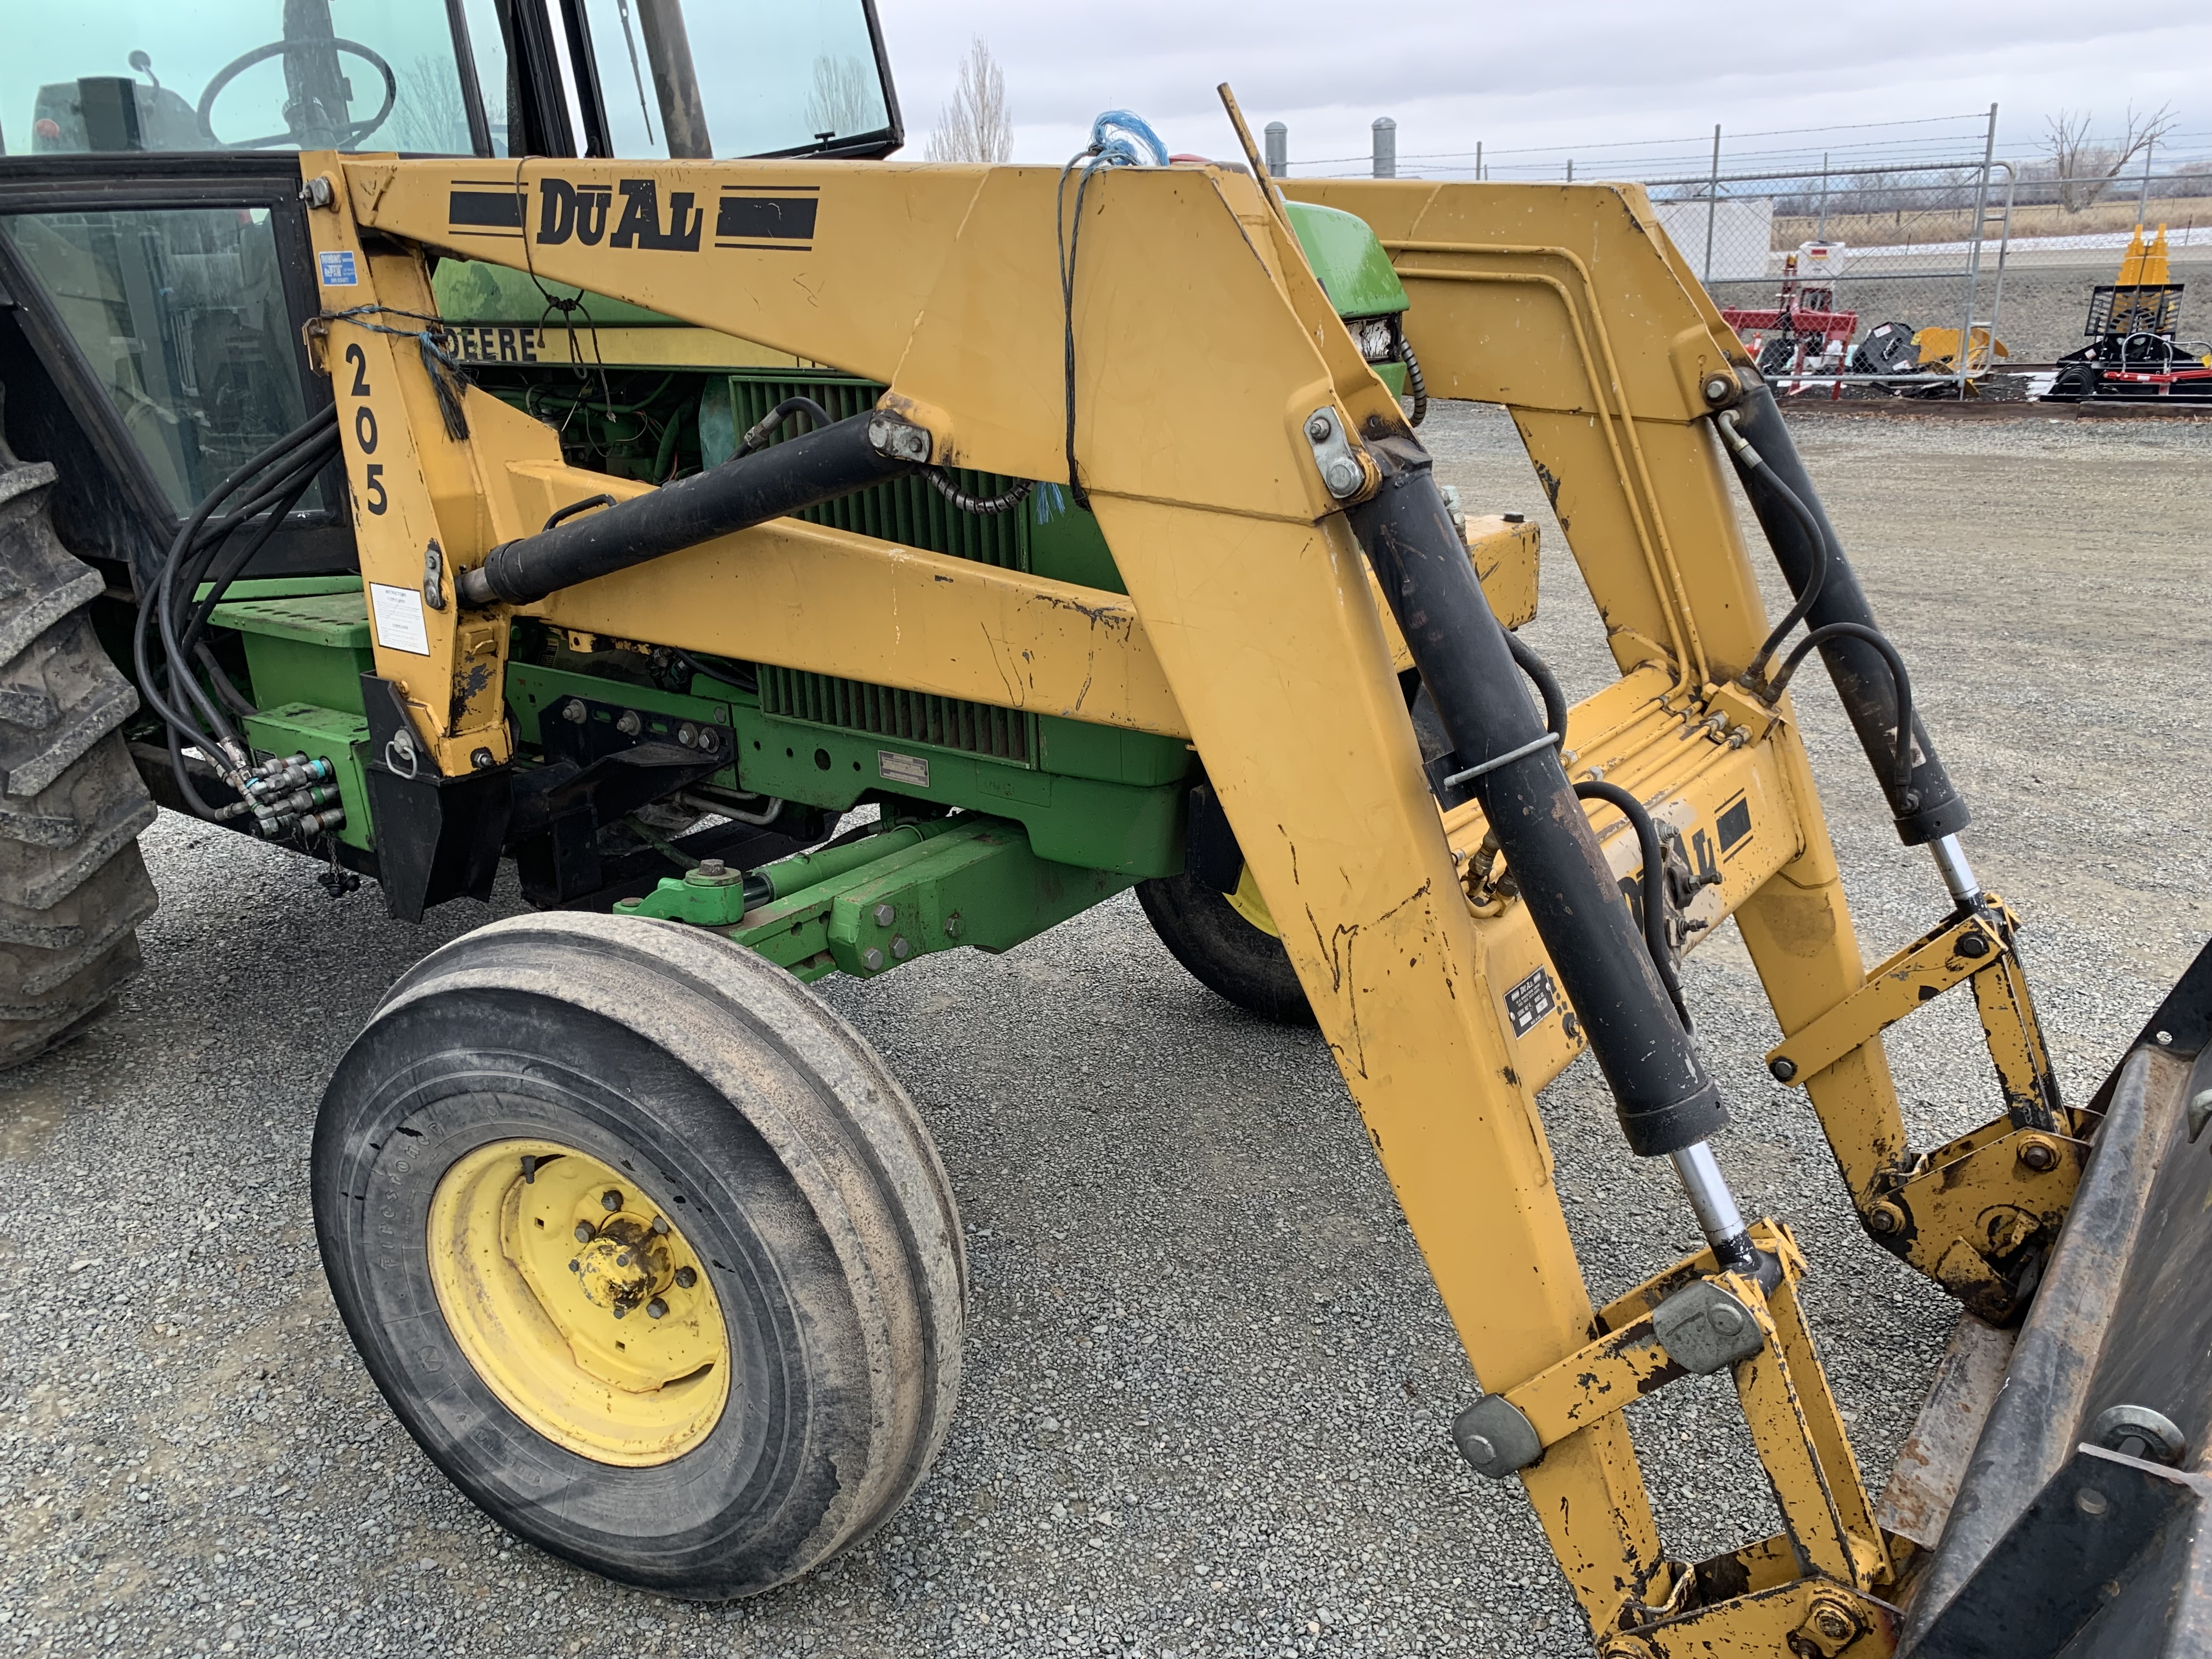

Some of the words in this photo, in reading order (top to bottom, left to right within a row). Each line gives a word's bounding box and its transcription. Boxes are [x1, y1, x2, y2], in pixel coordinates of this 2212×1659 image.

[444, 329, 537, 362] DEERE
[346, 343, 387, 516] 205
[380, 1131, 431, 1271] Firestone
